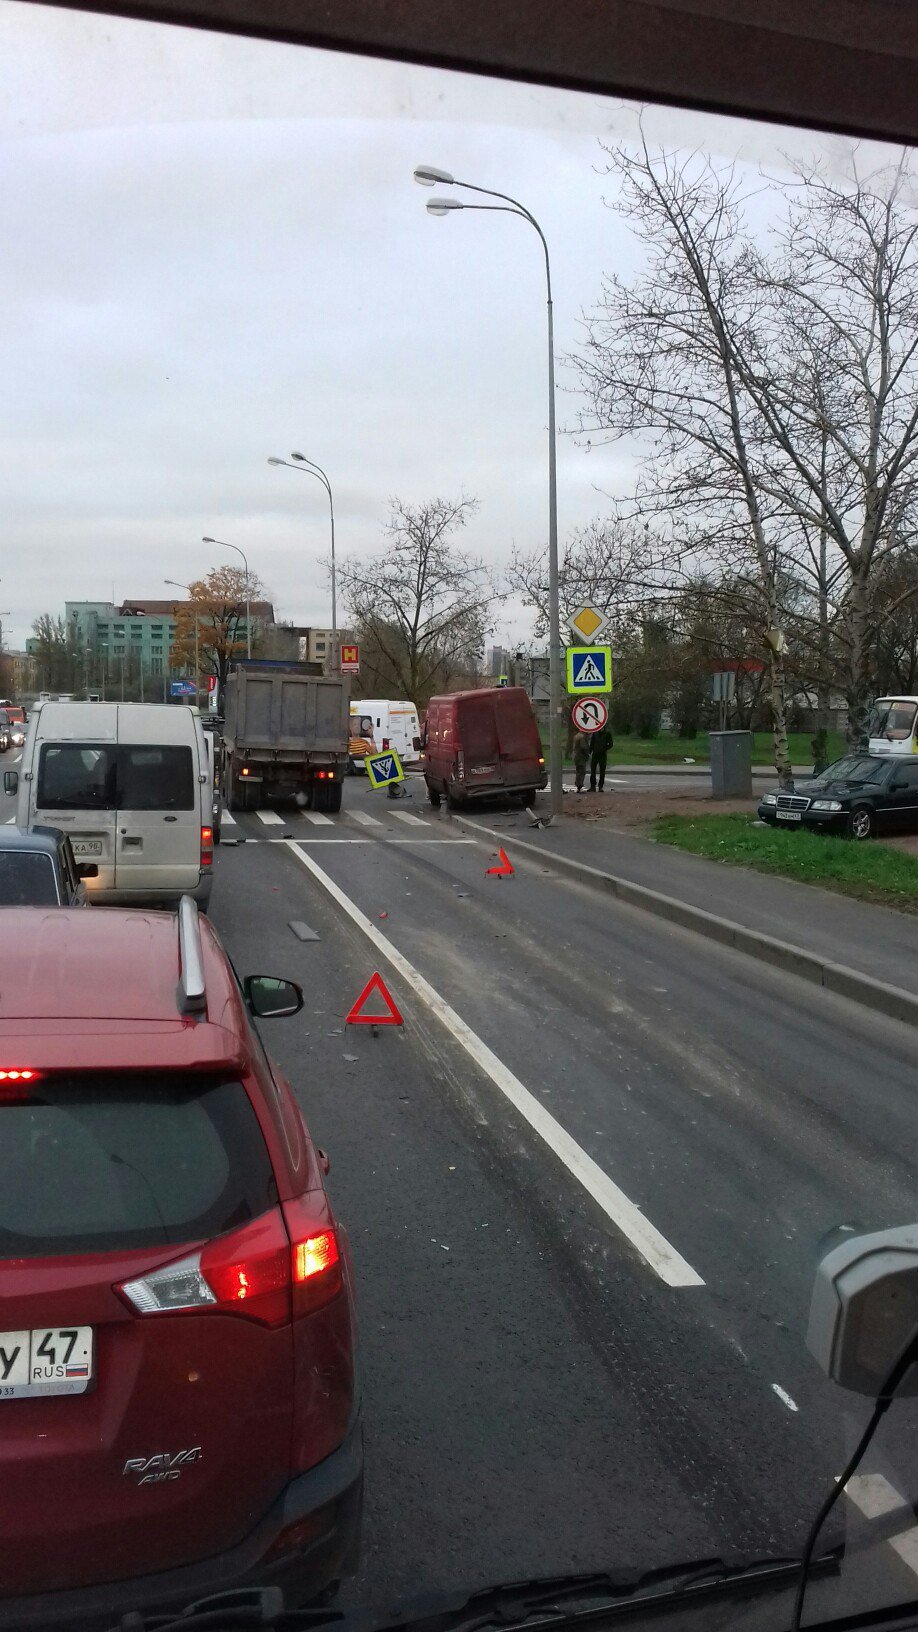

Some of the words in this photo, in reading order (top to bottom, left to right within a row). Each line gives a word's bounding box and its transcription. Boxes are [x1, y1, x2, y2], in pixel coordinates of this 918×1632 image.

[36, 1330, 79, 1365] 47
[33, 1365, 65, 1379] RUS
[122, 1446, 203, 1476] RAV4
[137, 1470, 181, 1486] AWD
